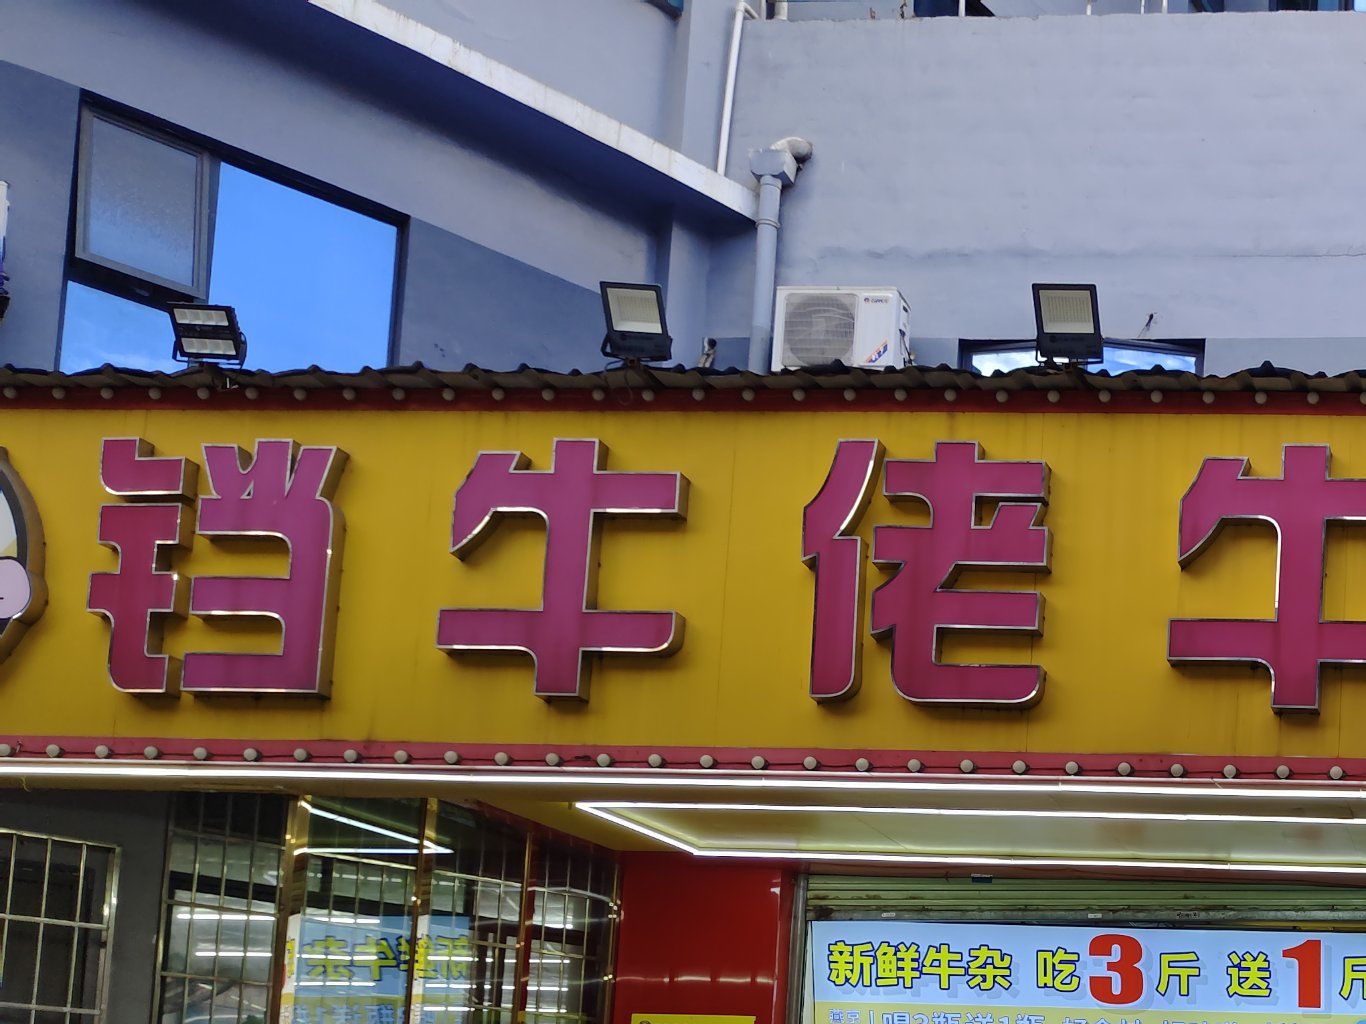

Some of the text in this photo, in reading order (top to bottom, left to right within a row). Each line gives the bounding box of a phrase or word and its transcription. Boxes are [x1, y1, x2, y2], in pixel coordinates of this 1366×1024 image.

[827, 940, 1012, 990] 新鲜牛杂
[829, 1008, 861, 1024] 燕京
